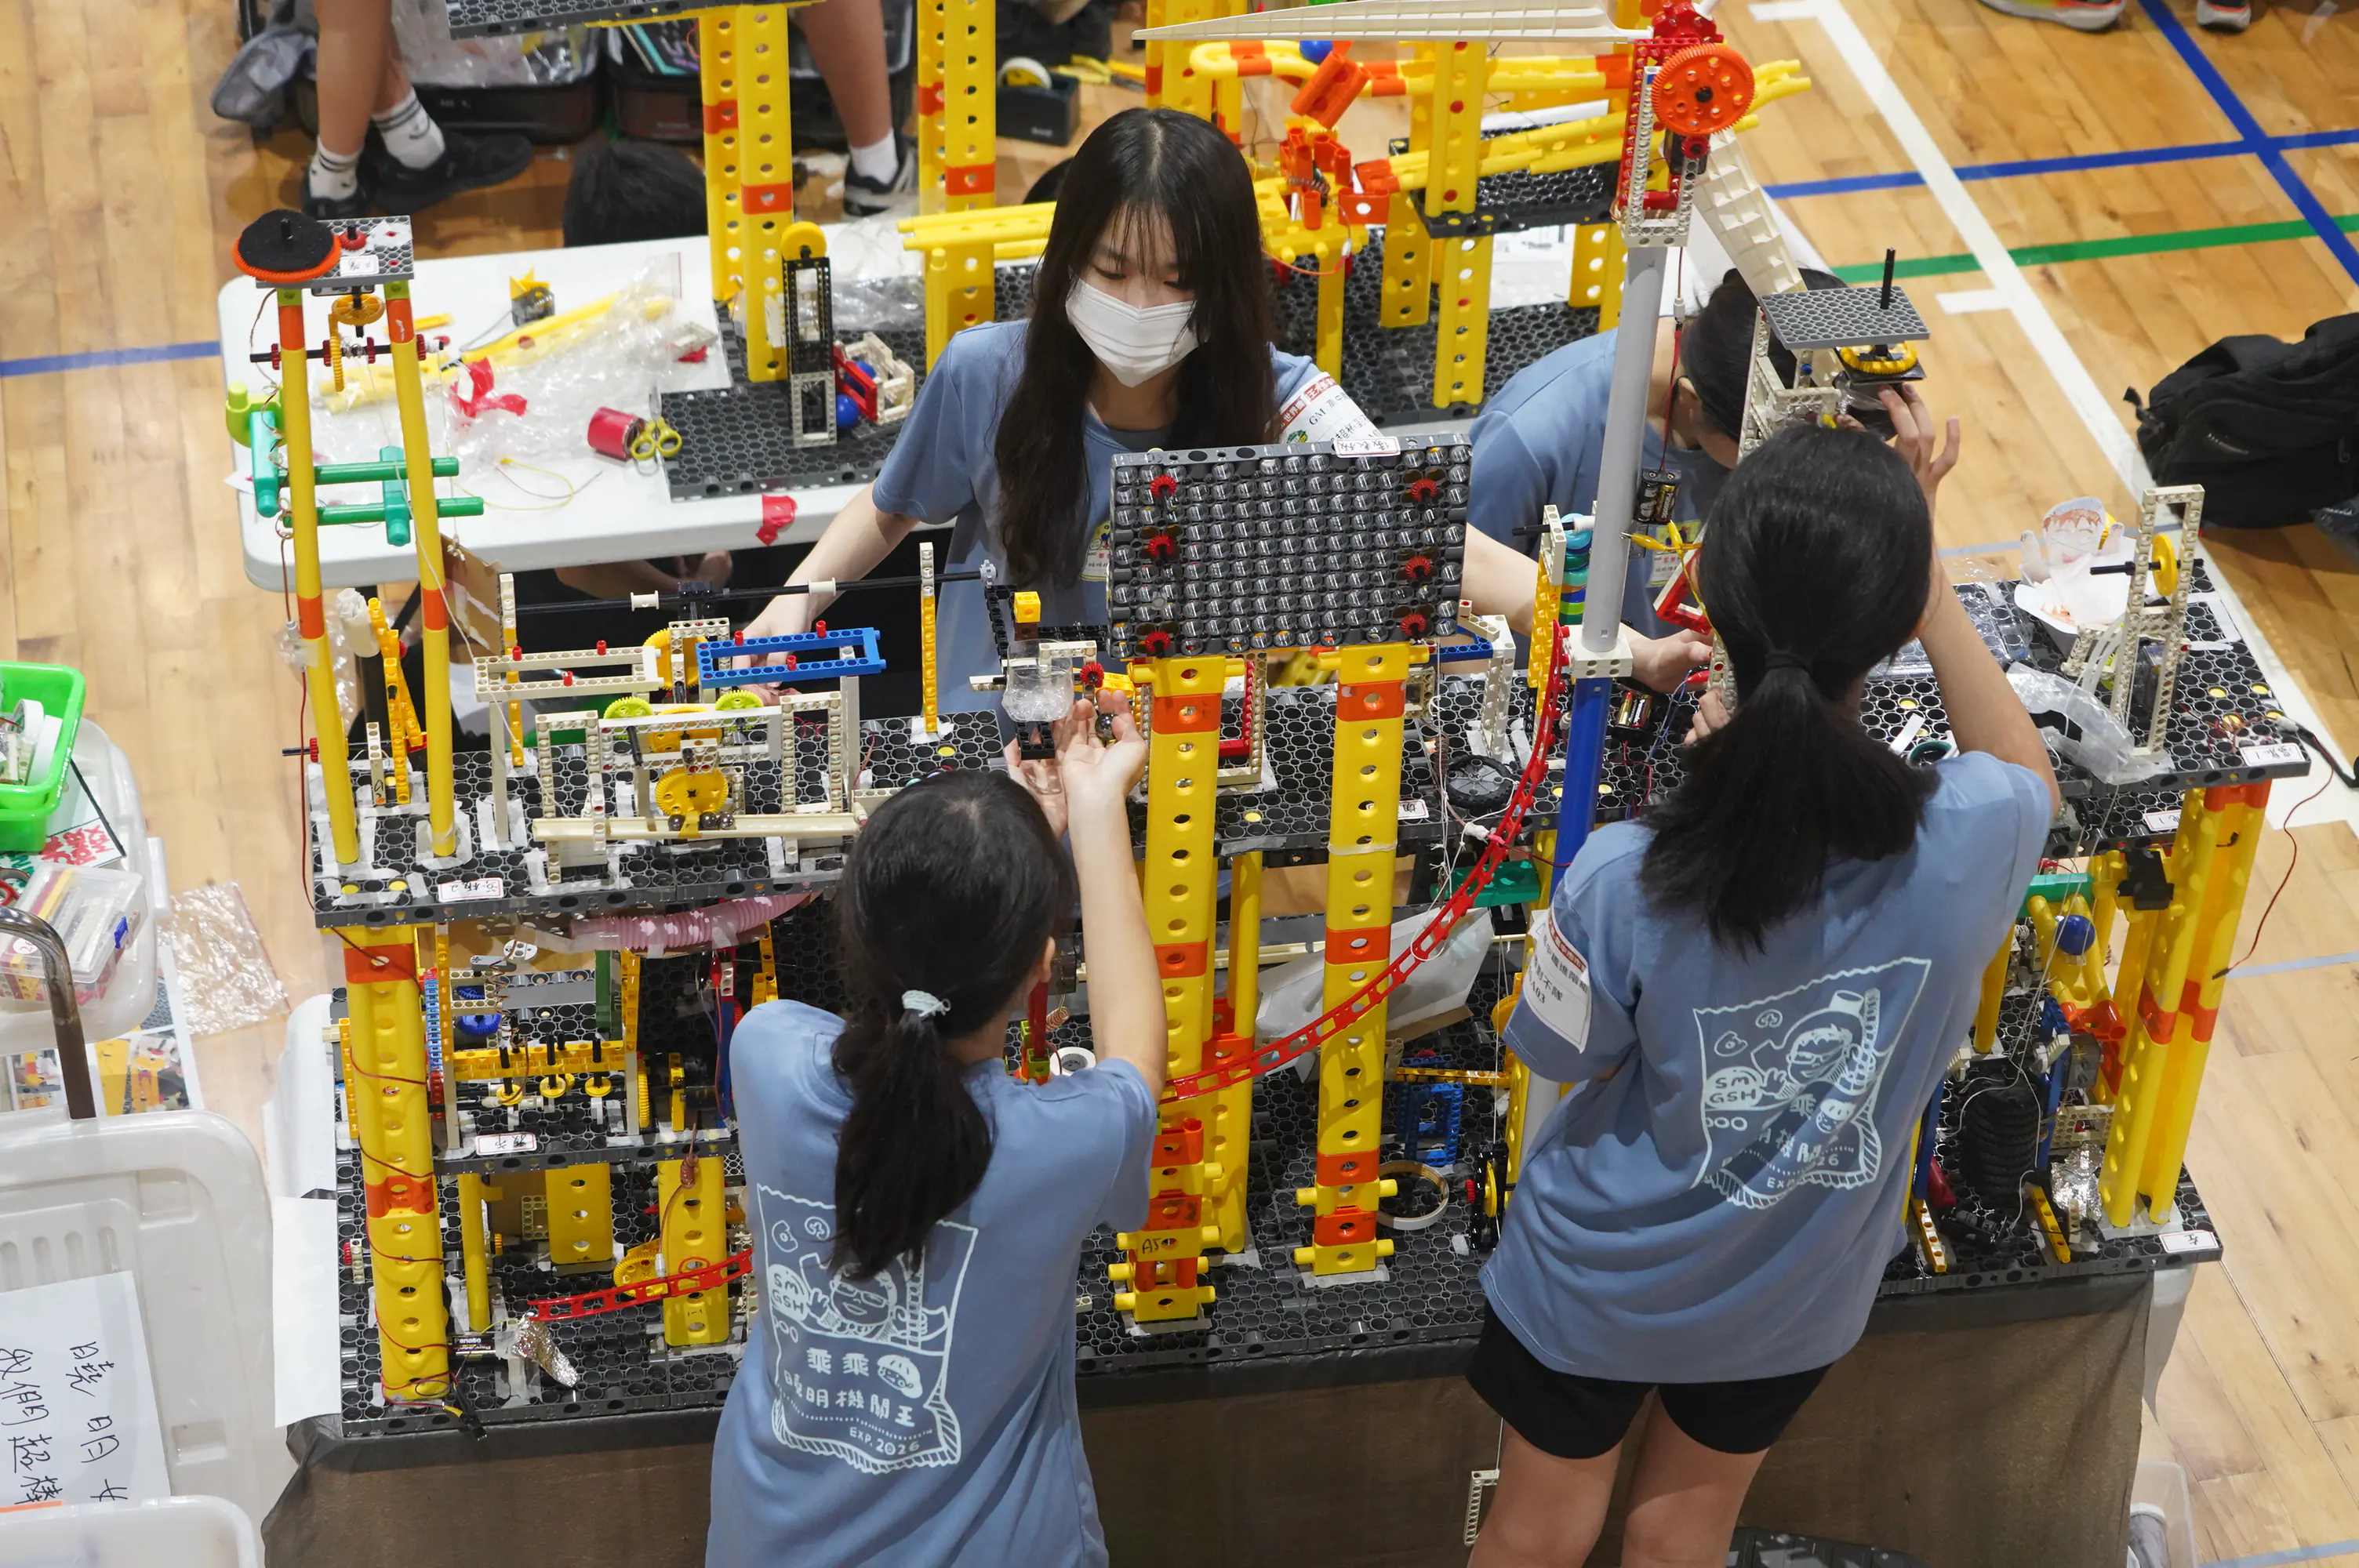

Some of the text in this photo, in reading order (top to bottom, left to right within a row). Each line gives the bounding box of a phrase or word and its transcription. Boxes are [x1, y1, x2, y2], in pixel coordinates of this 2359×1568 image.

[1309, 407, 1326, 426] GM
[1715, 1076, 1750, 1089] SM
[1709, 1088, 1757, 1104] GSH
[773, 1272, 800, 1296] SM
[771, 1289, 805, 1315] GSH
[806, 1346, 870, 1377] 乖乖
[849, 1426, 920, 1455] EXP. 2026
